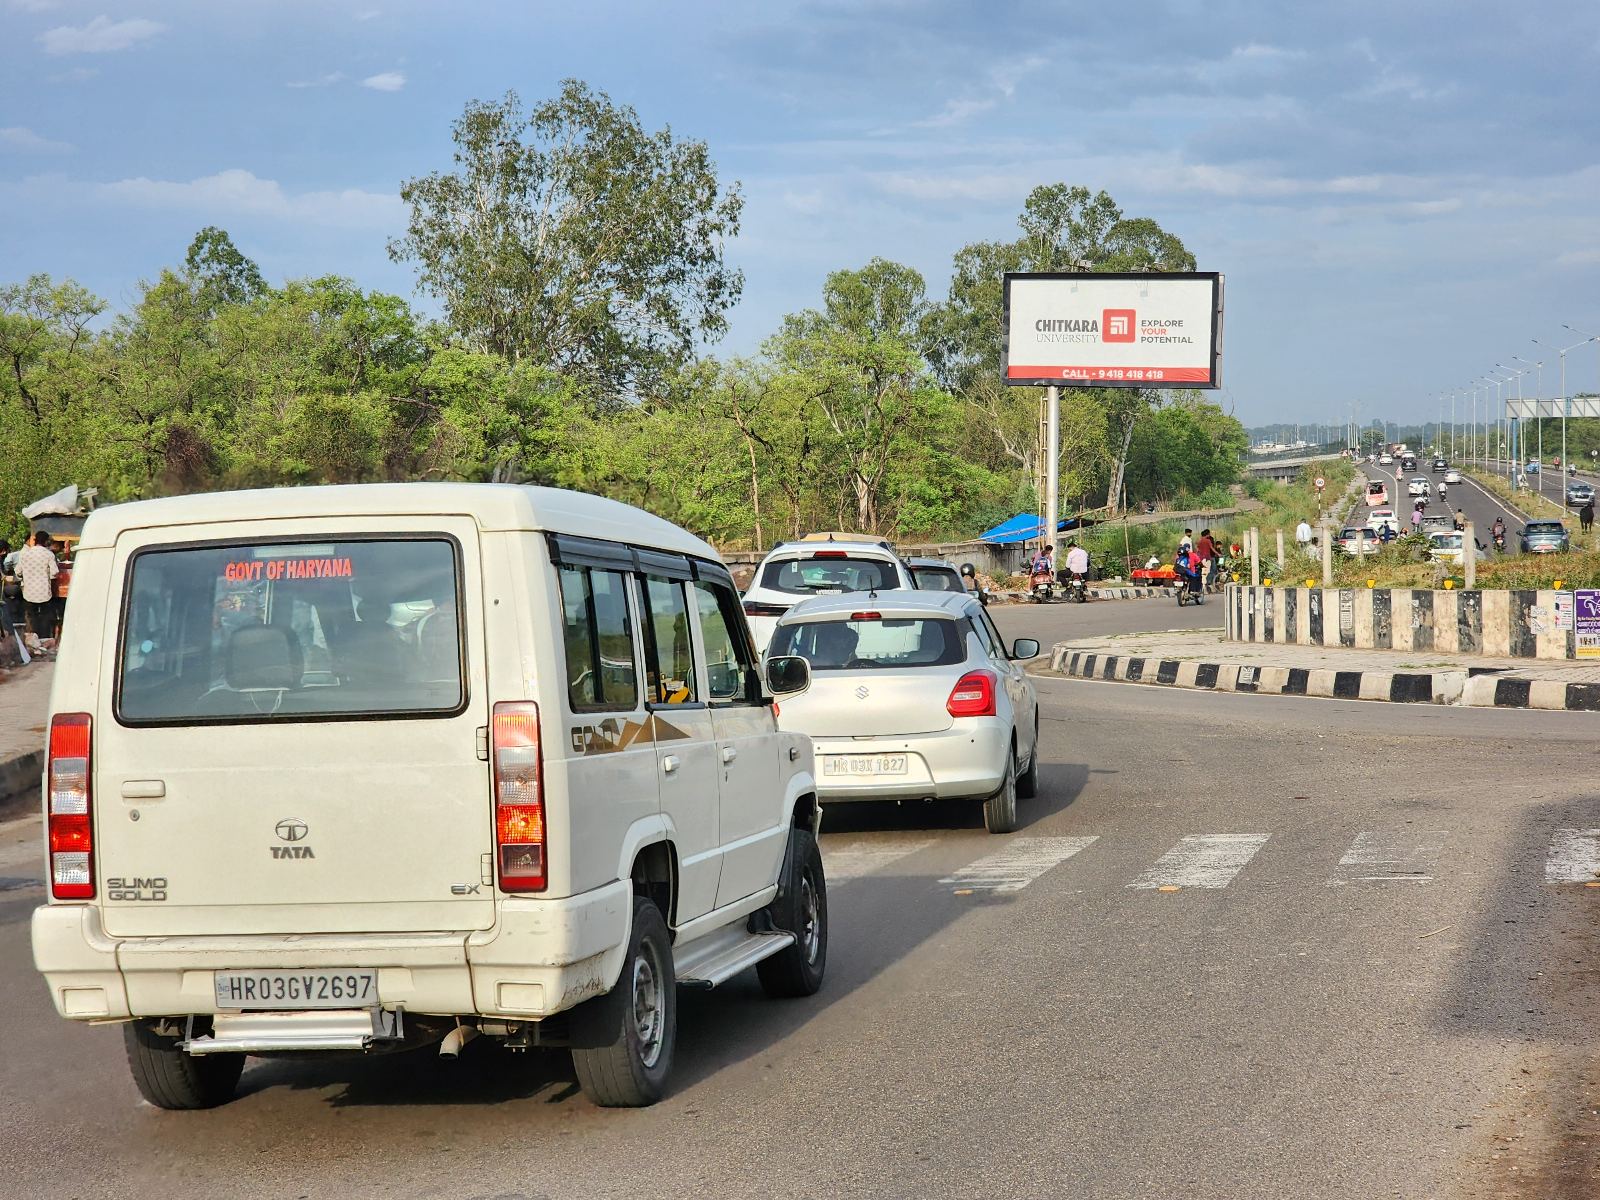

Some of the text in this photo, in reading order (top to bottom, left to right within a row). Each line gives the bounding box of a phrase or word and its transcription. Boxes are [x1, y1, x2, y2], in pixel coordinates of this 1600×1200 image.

[1035, 319, 1099, 333] CHITKARA
[1036, 334, 1099, 344] UNIVERSITY
[1140, 336, 1193, 344] POTENTIAL
[1062, 369, 1089, 378] CALL
[1126, 370, 1143, 379] 418
[1146, 370, 1163, 379] 418
[225, 558, 352, 581] GOVT OF HARYANA
[270, 846, 315, 859] TATA
[107, 878, 168, 889] SUMO
[451, 883, 481, 895] EX
[108, 890, 168, 901] GOLD
[230, 975, 372, 1000] HR03GV2697
